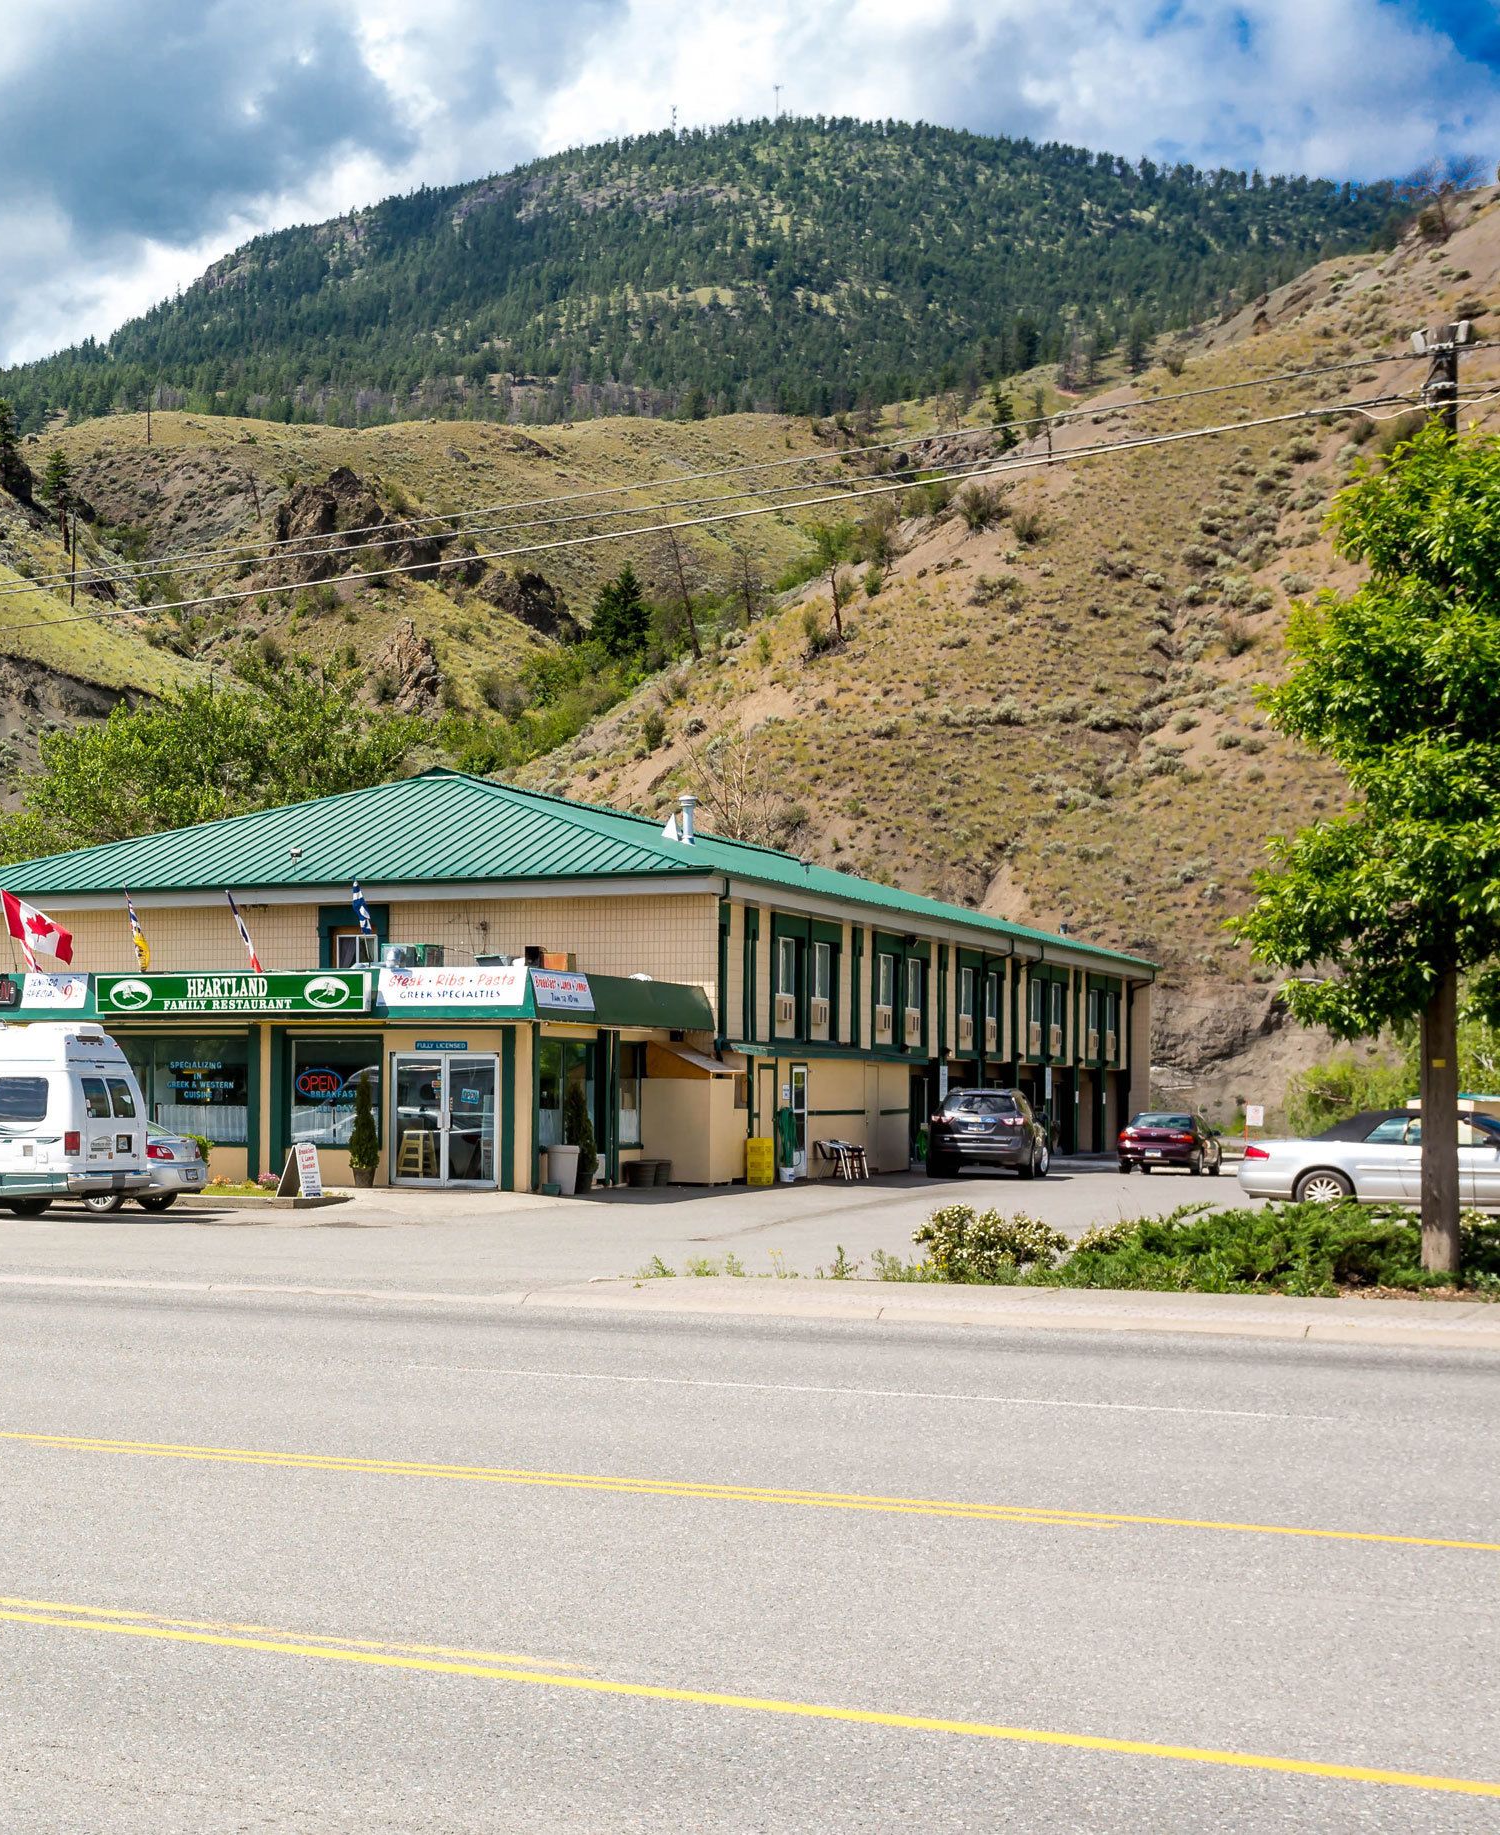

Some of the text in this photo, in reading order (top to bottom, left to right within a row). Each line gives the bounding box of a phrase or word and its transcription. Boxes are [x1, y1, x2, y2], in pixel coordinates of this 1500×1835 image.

[389, 973, 517, 987] Steak Ribs Pasta
[186, 977, 268, 998] HEARTLAND
[399, 990, 501, 999] GREEK SPECIALTIES
[163, 999, 293, 1011] FAMILY RESTAURANT
[170, 1061, 222, 1069] SPECIALIZING
[193, 1072, 202, 1080] IN
[166, 1081, 234, 1089] GREEK & WESTERN
[298, 1075, 337, 1092] OPEN
[183, 1090, 213, 1099] CUISINE
